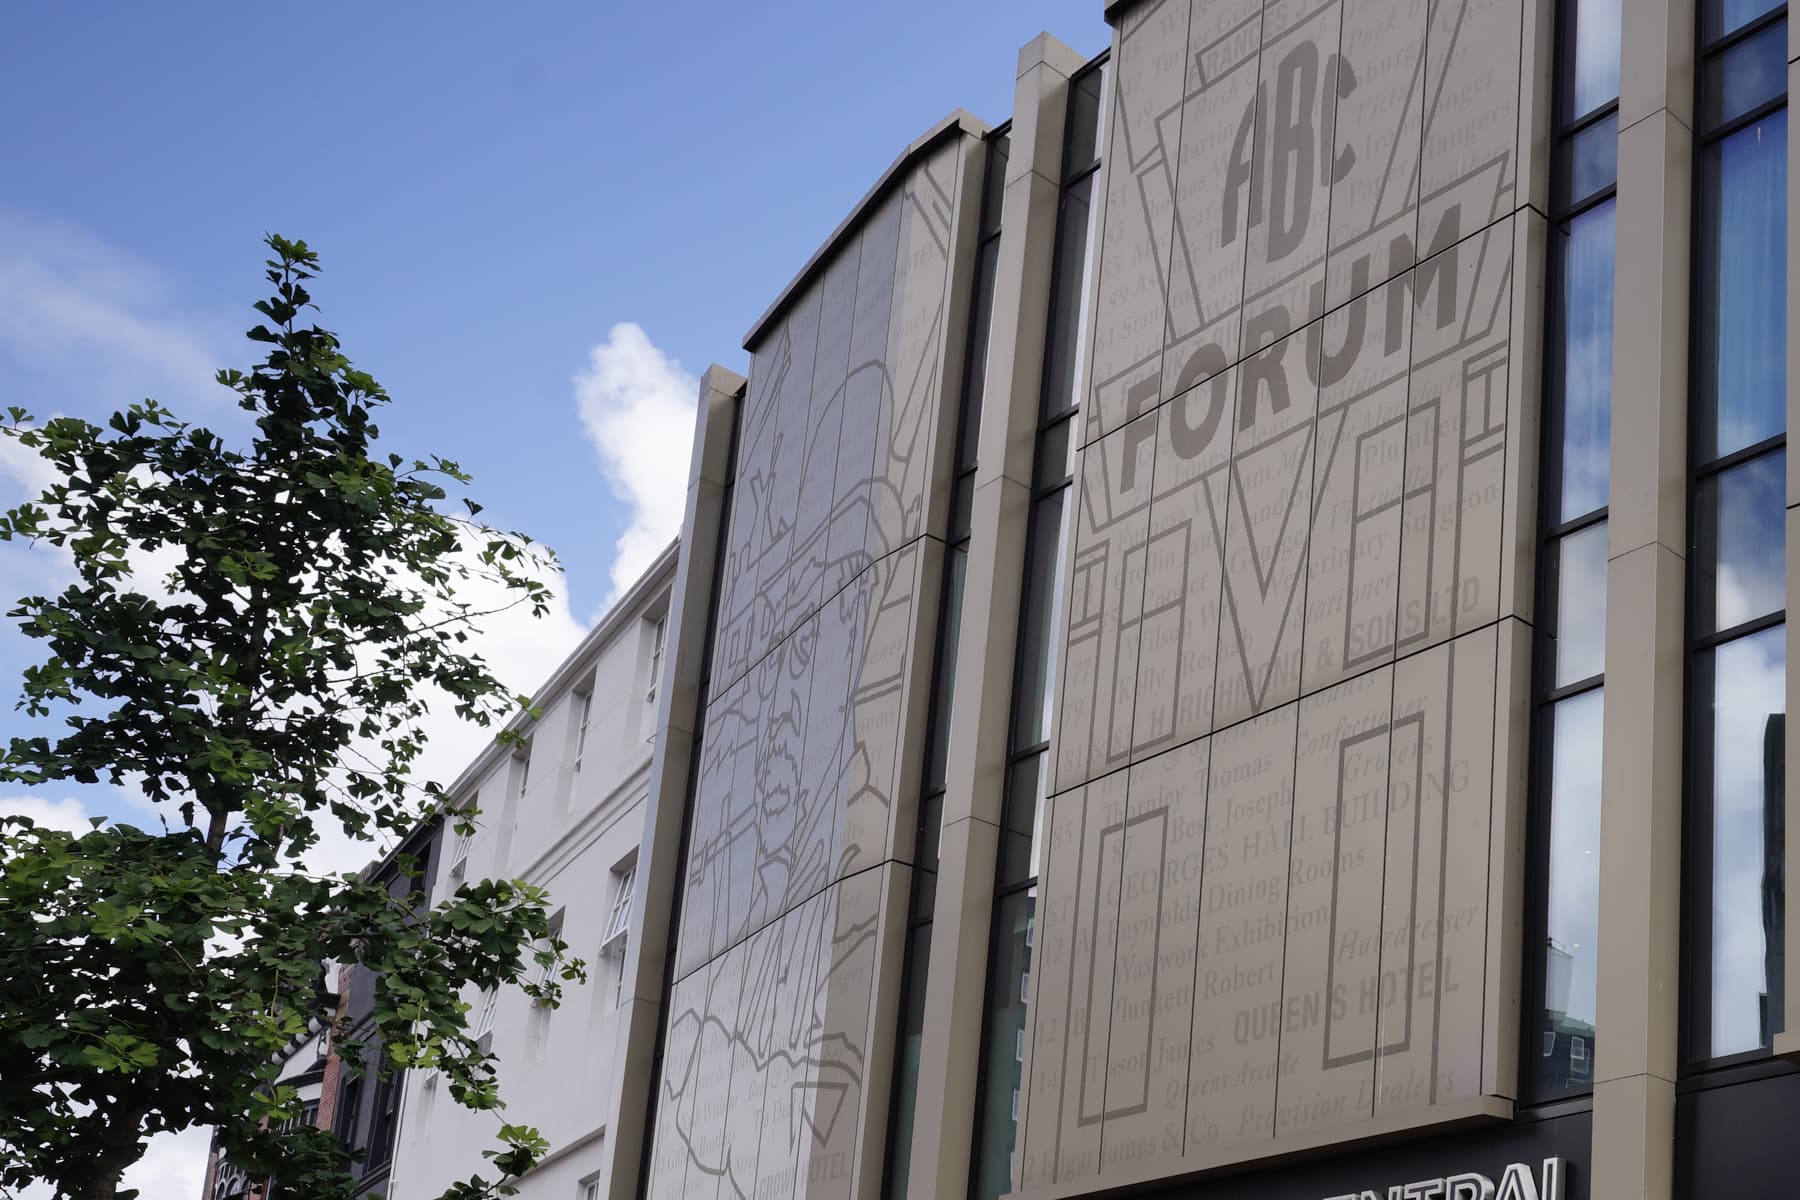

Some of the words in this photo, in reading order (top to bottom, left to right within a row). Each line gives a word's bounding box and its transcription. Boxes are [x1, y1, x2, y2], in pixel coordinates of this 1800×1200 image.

[1221, 39, 1358, 264] ABC
[1119, 202, 1460, 495] FORUM
[1315, 632, 1336, 674] &
[1349, 596, 1422, 661] SONS
[1063, 697, 1084, 728] 79
[1169, 804, 1214, 846] Best
[1221, 774, 1293, 837] Joseph
[1045, 892, 1073, 929] ST
[1241, 810, 1314, 865] HALL
[1206, 862, 1282, 916] Dining
[1203, 950, 1277, 1002] Robert
[1359, 950, 1460, 1016] HOTEL
[1189, 1109, 1220, 1147] Co
